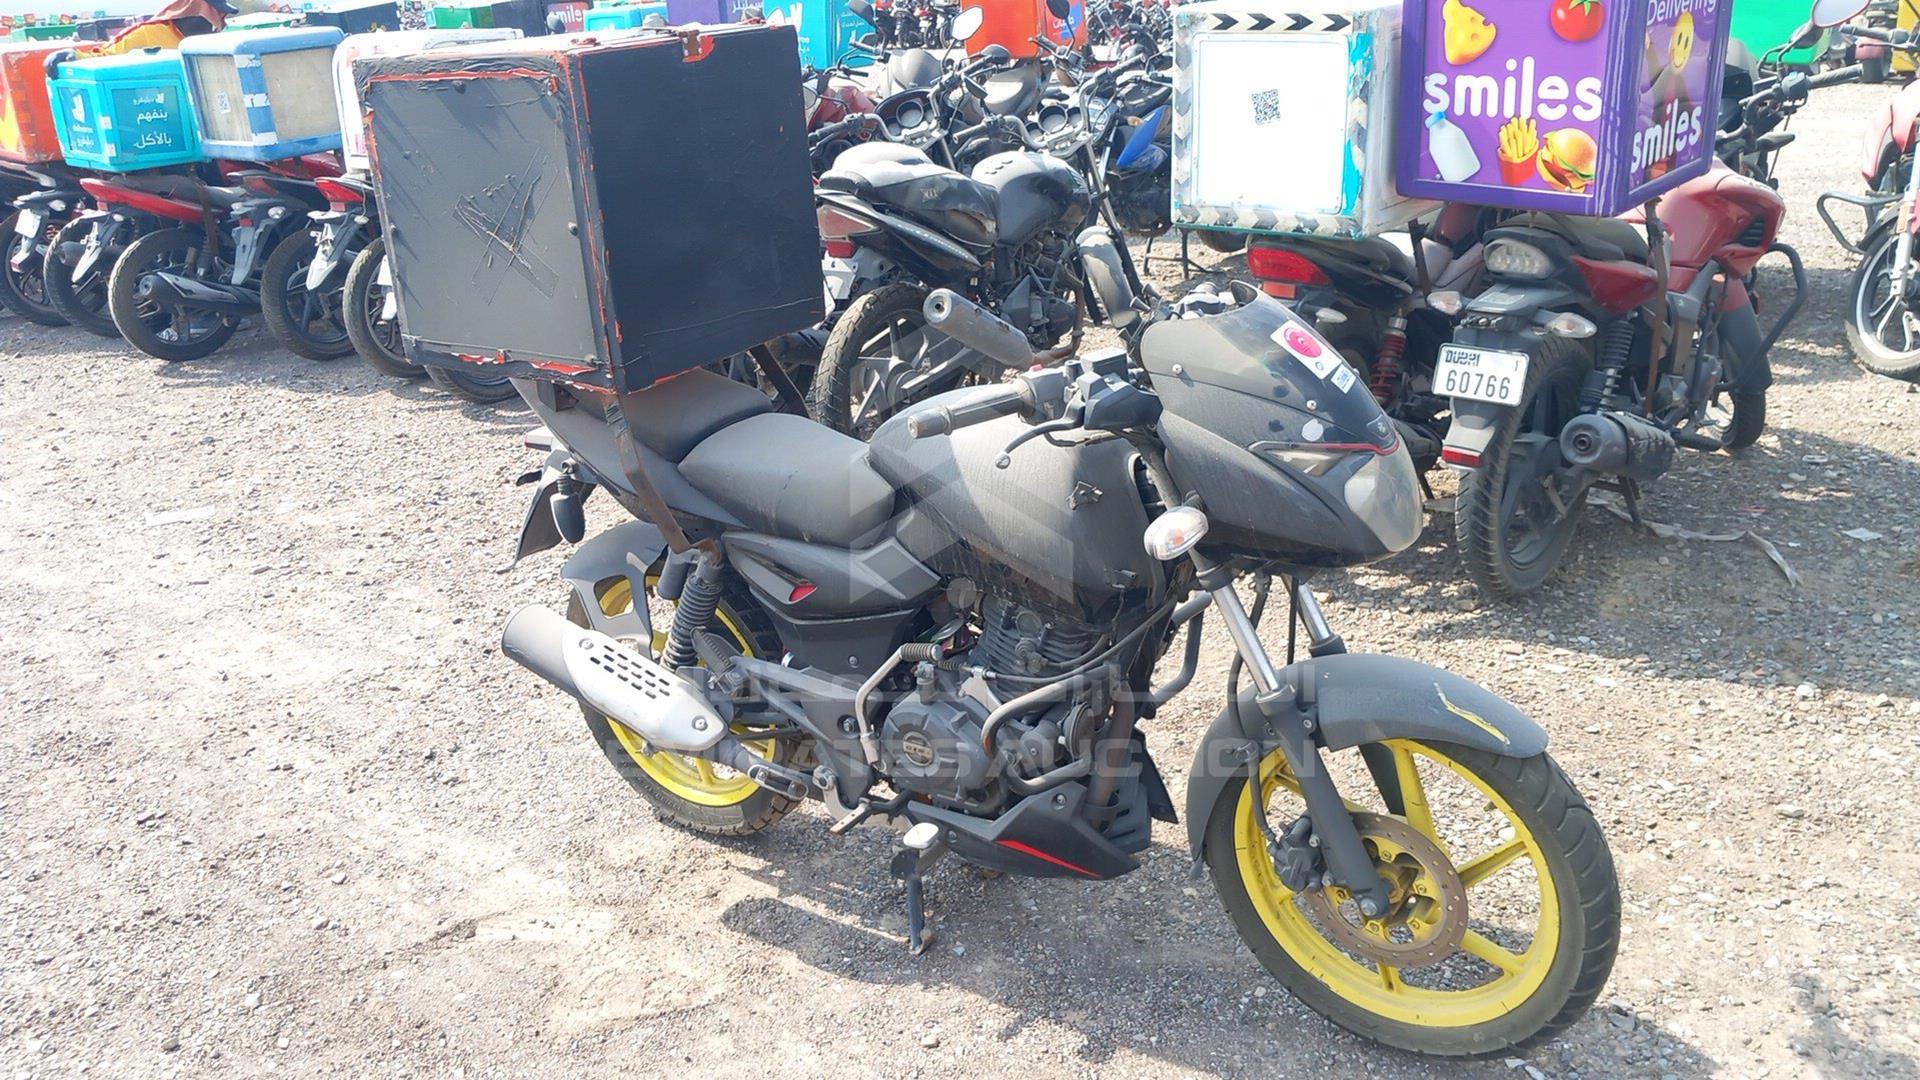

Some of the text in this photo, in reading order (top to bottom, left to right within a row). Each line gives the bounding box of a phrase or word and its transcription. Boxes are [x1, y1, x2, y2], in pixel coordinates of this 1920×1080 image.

[1423, 56, 1602, 122] smiles
[1631, 98, 1702, 173] smiles
[1446, 369, 1510, 400] 60766
